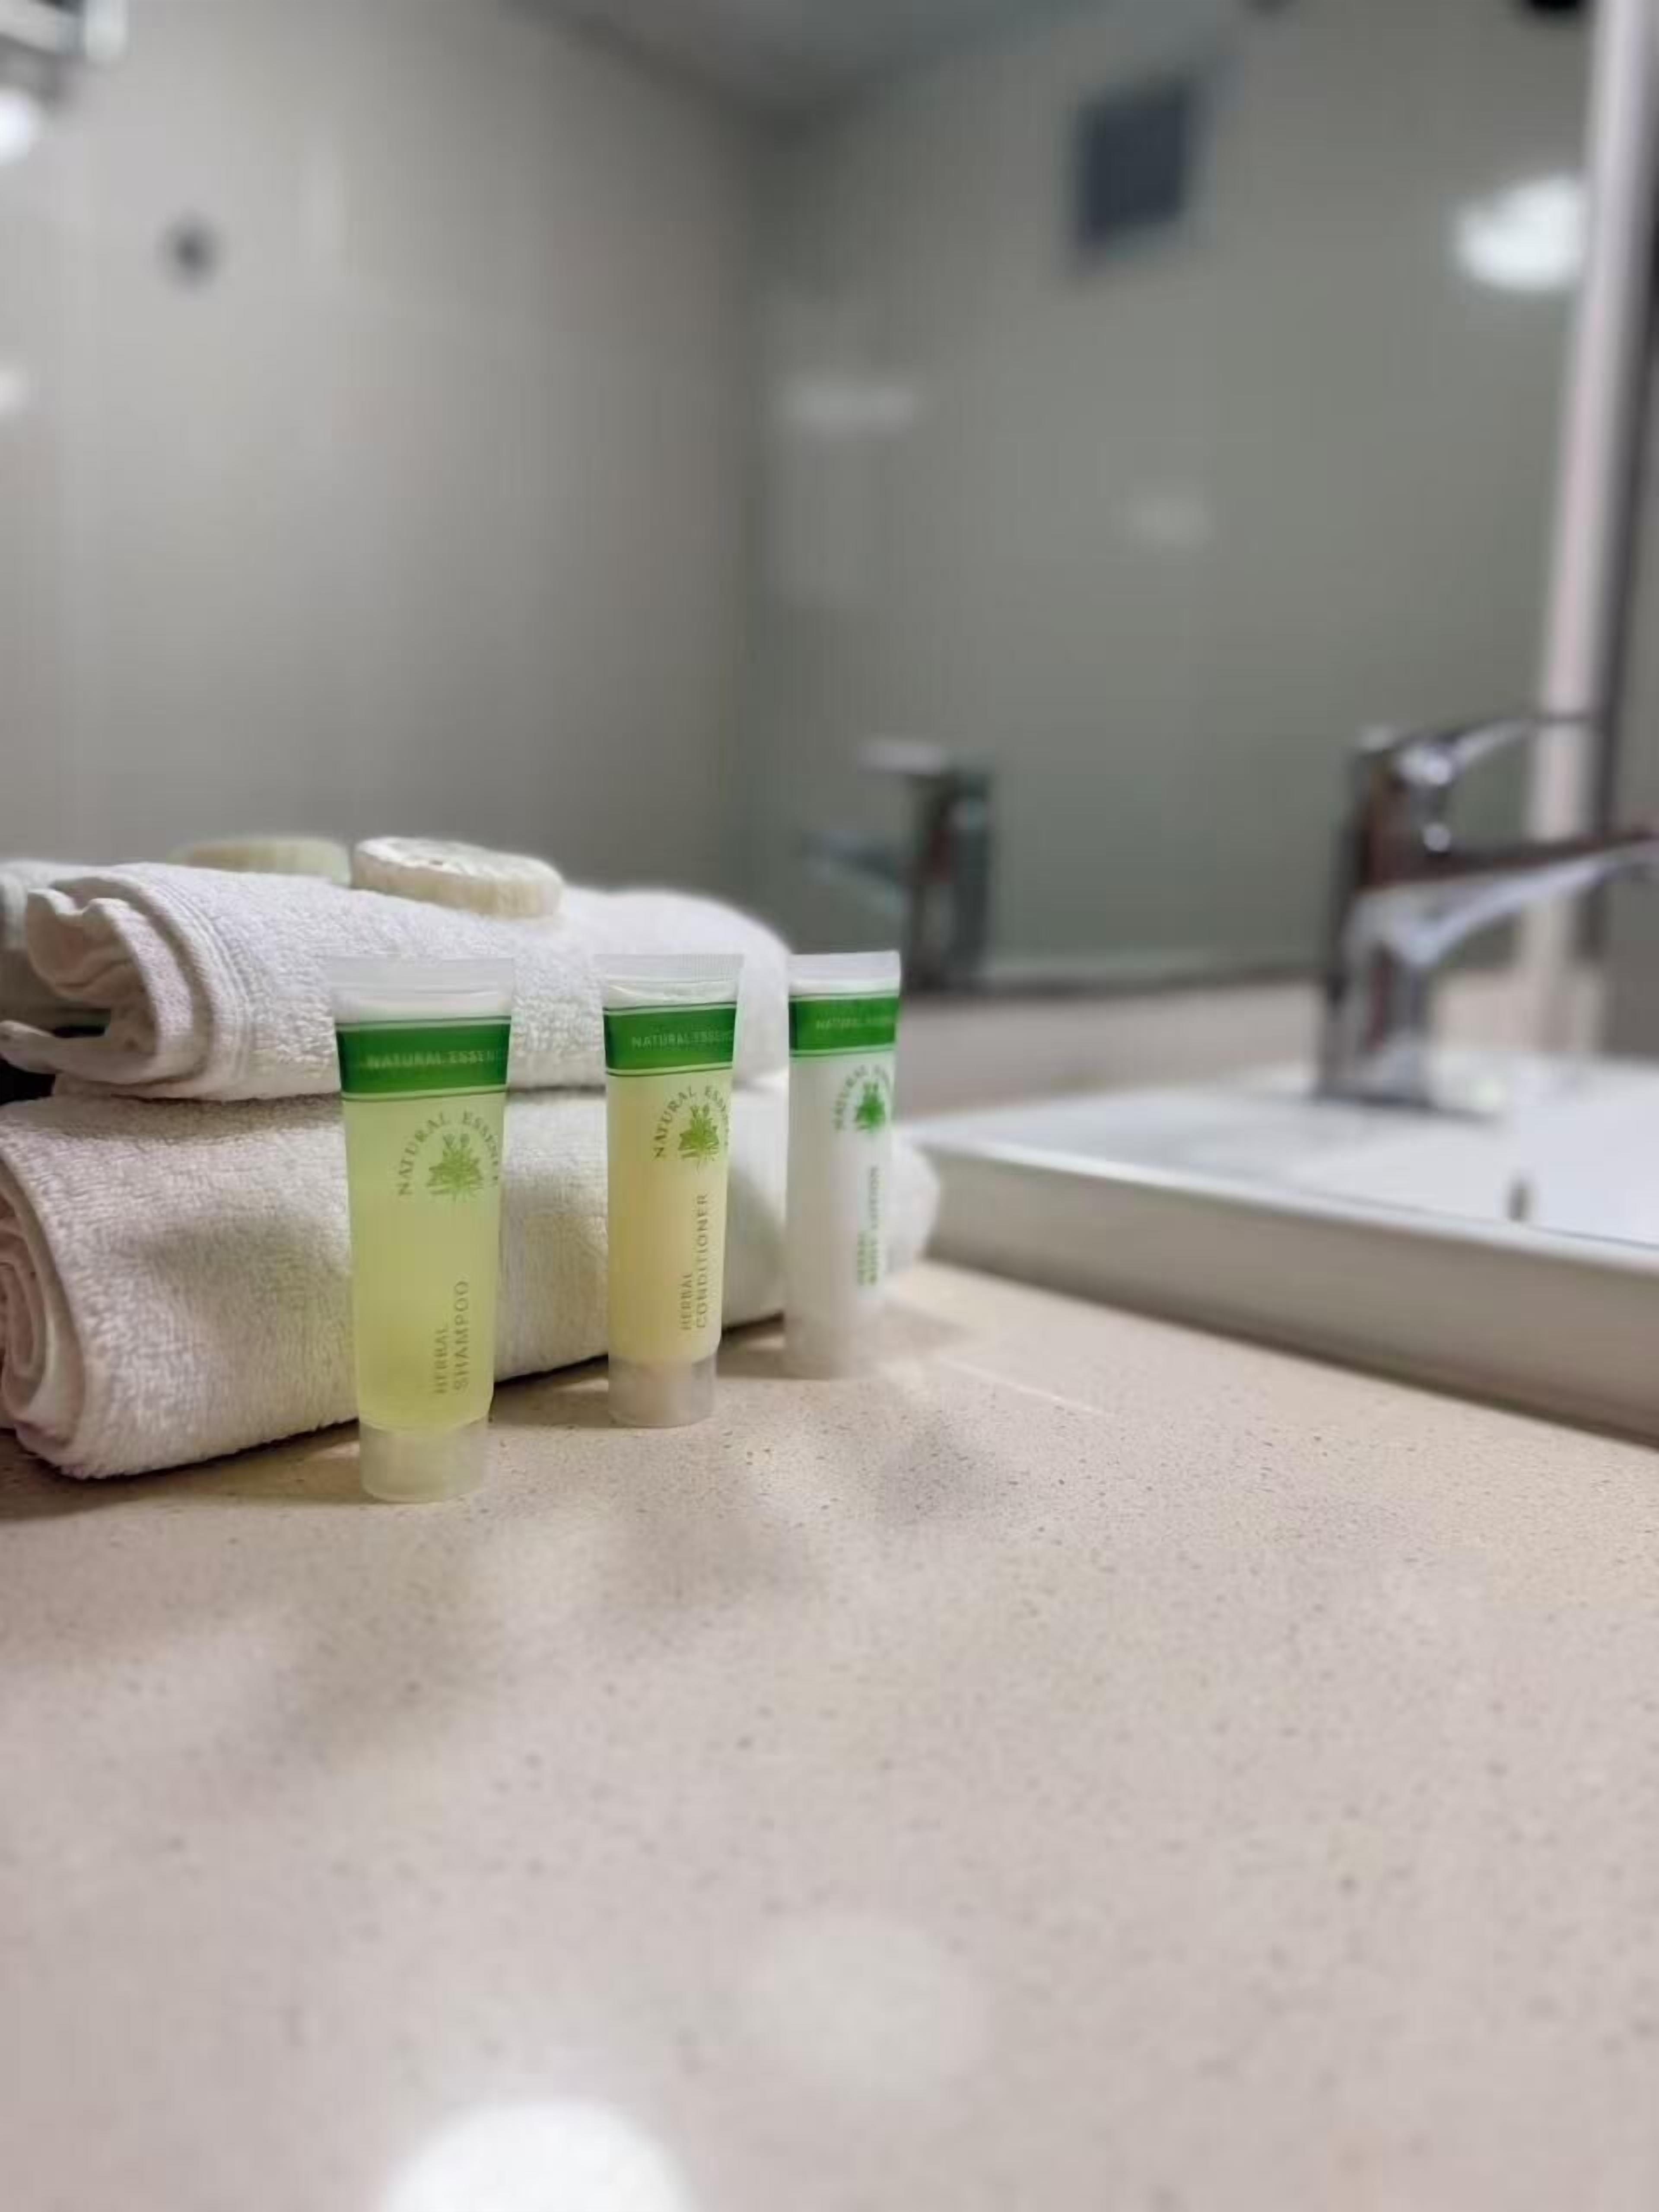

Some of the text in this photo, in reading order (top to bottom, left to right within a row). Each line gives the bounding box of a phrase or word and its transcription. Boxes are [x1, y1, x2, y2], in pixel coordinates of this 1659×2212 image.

[366, 1051, 442, 1069] NATURAL
[631, 1032, 689, 1051] NATURAL
[396, 1111, 451, 1196] NATURAL
[653, 1085, 696, 1158] NATURAL
[696, 1192, 708, 1328] CONDITIONER
[454, 1281, 470, 1390] SHAMPOO
[680, 1273, 692, 1330] HERBAL
[434, 1324, 448, 1393] HERBAL
